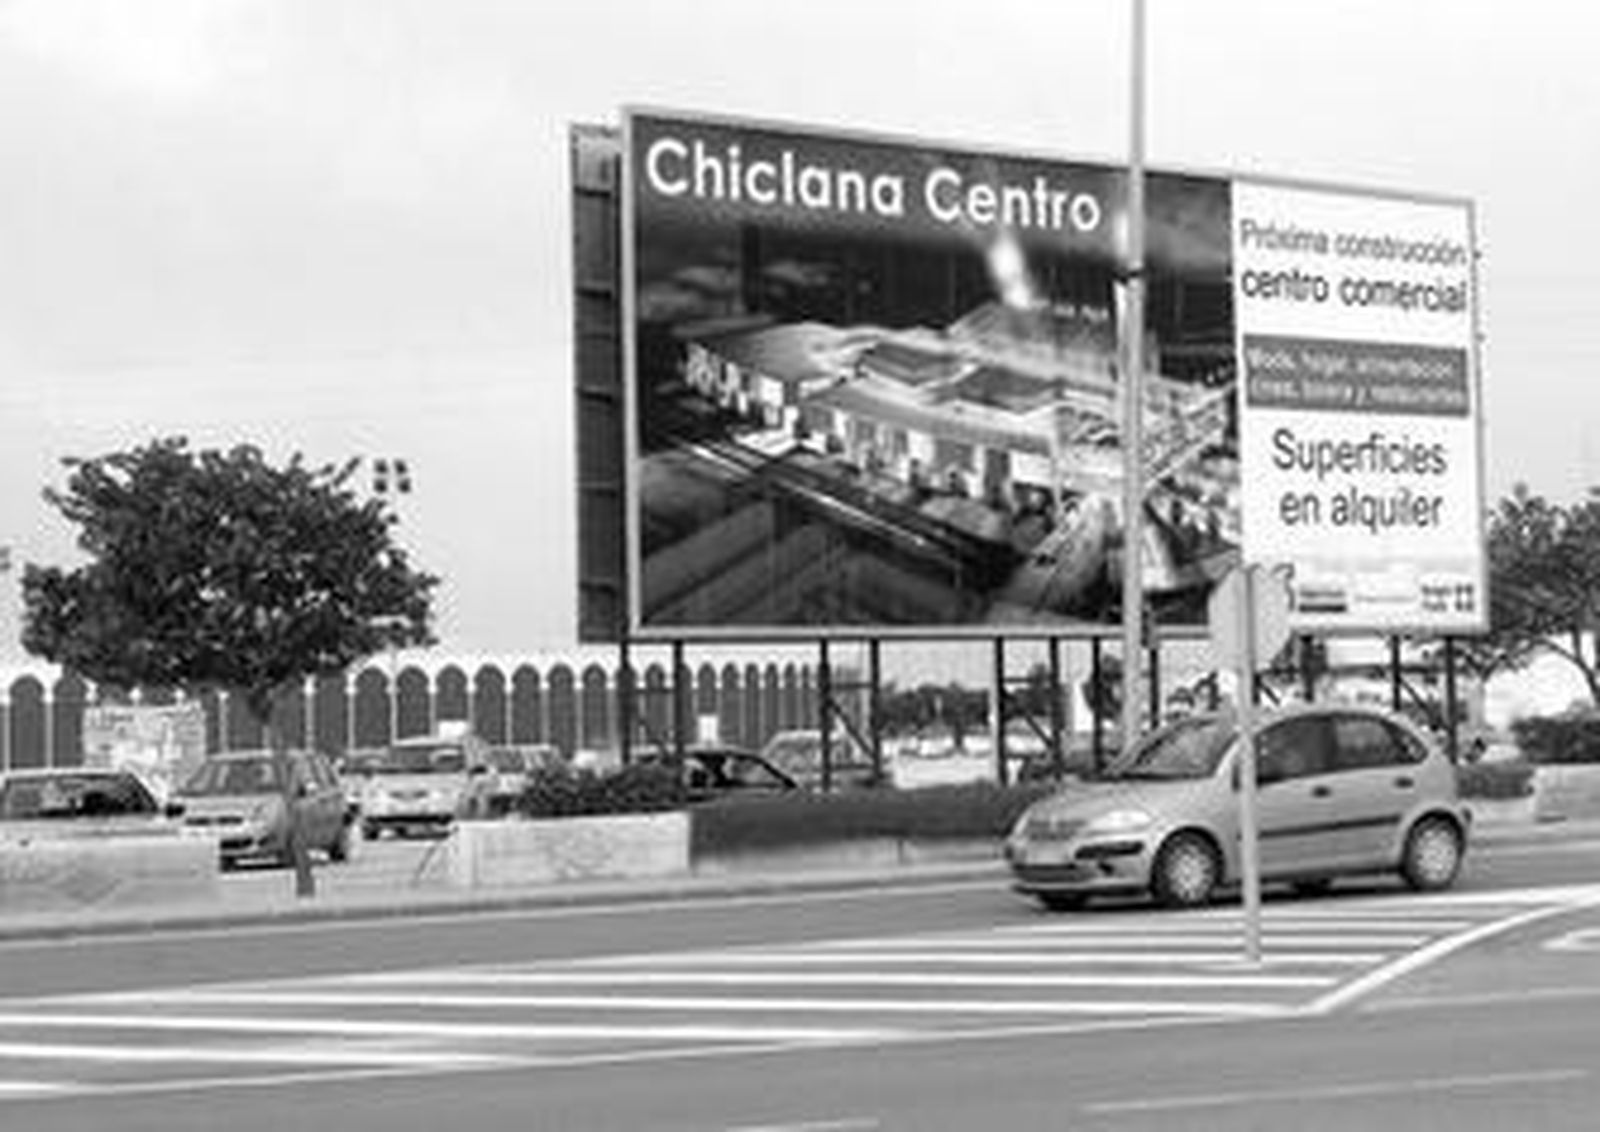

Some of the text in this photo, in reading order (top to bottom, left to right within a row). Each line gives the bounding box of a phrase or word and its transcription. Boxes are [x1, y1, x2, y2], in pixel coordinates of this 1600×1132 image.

[645, 138, 1101, 232] Chiclana Centro
[1241, 266, 1467, 313] centro comercial
[1272, 428, 1448, 481] Superficies
[1279, 486, 1443, 535] en alquiler
